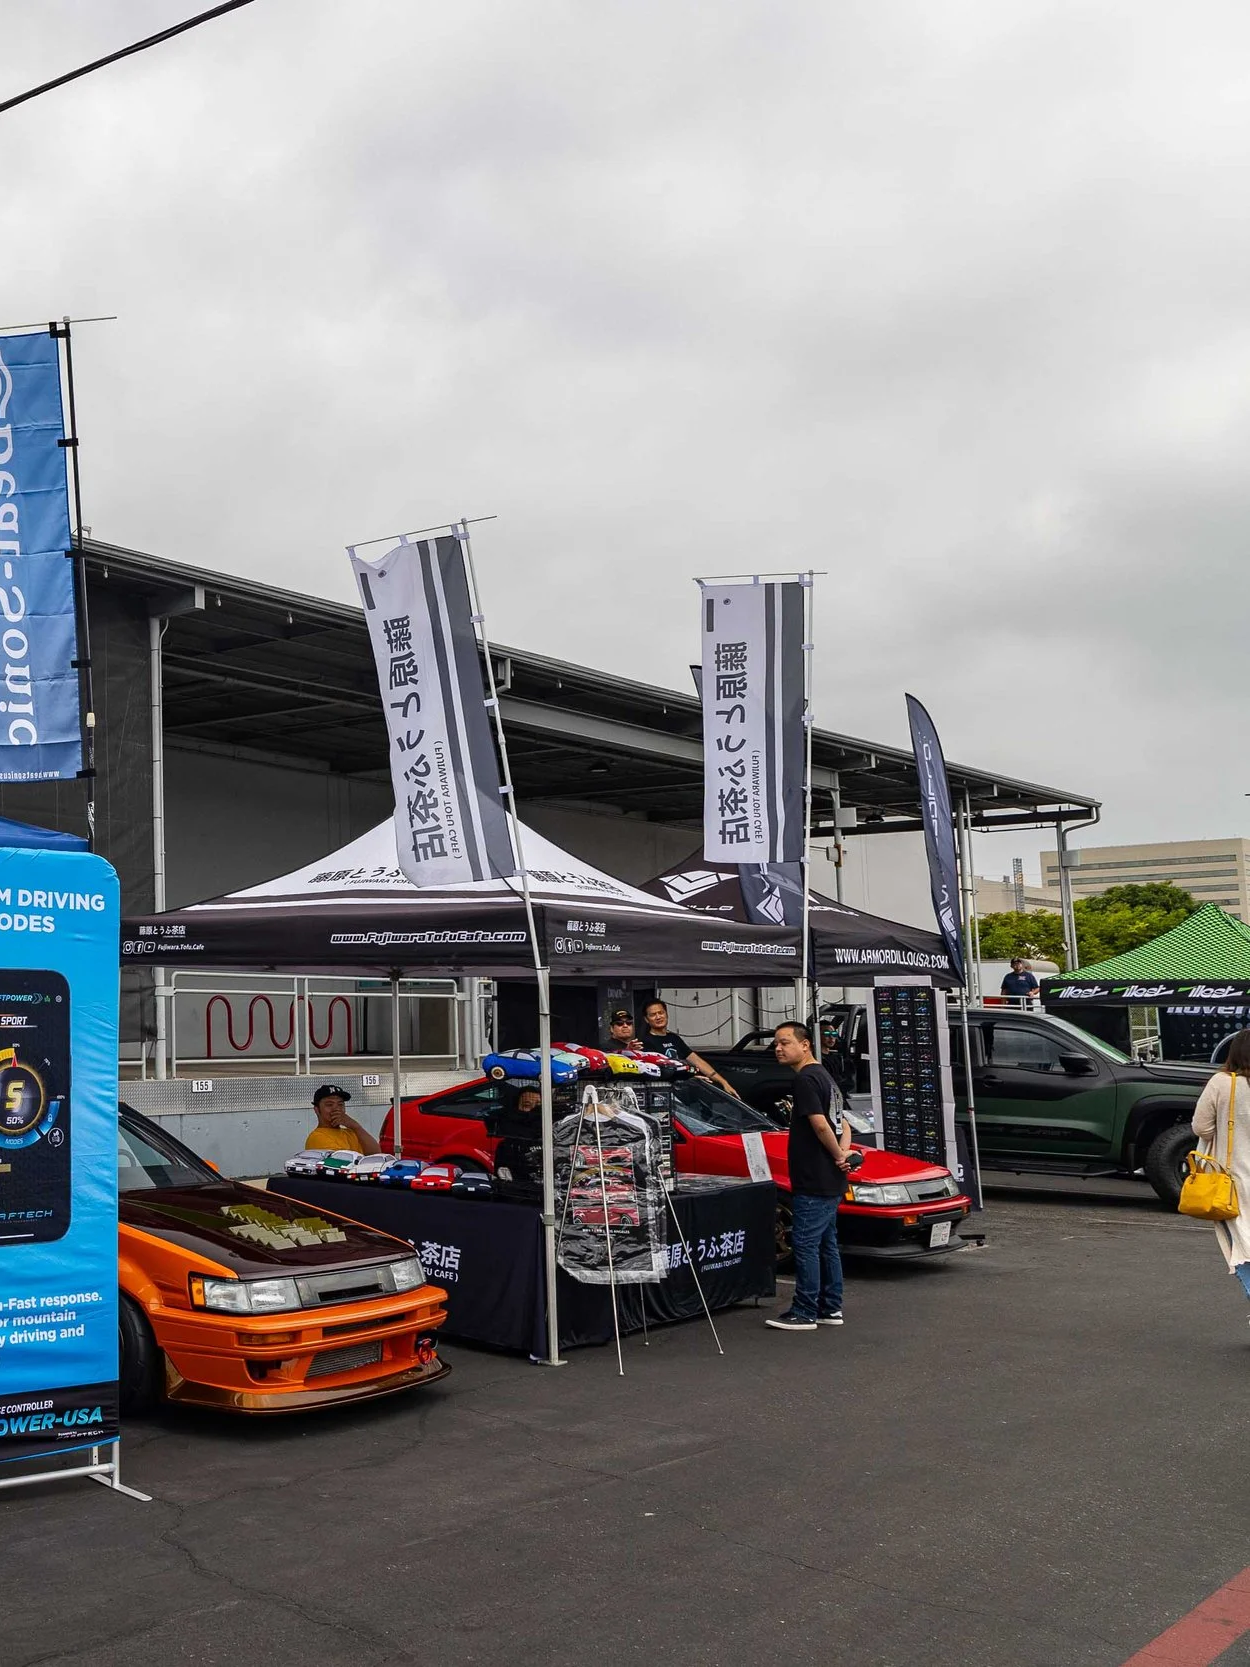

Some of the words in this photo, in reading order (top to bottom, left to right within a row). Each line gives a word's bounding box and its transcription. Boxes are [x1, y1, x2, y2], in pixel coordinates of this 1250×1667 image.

[17, 889, 105, 911] DRIVING
[331, 930, 527, 945] www.FujiwaraTofuCafe.com
[834, 948, 950, 970] WWW.ARMORDILLOUSA.COM
[0, 1016, 28, 1026] SPORT
[195, 1082, 209, 1091] 155
[365, 1075, 377, 1085] 156
[6, 1116, 24, 1125] 50%
[39, 1291, 103, 1309] response.
[12, 1309, 77, 1327] mountain
[9, 1328, 57, 1345] driving
[59, 1324, 85, 1338] and
[6, 1400, 54, 1414] CONTROLLER
